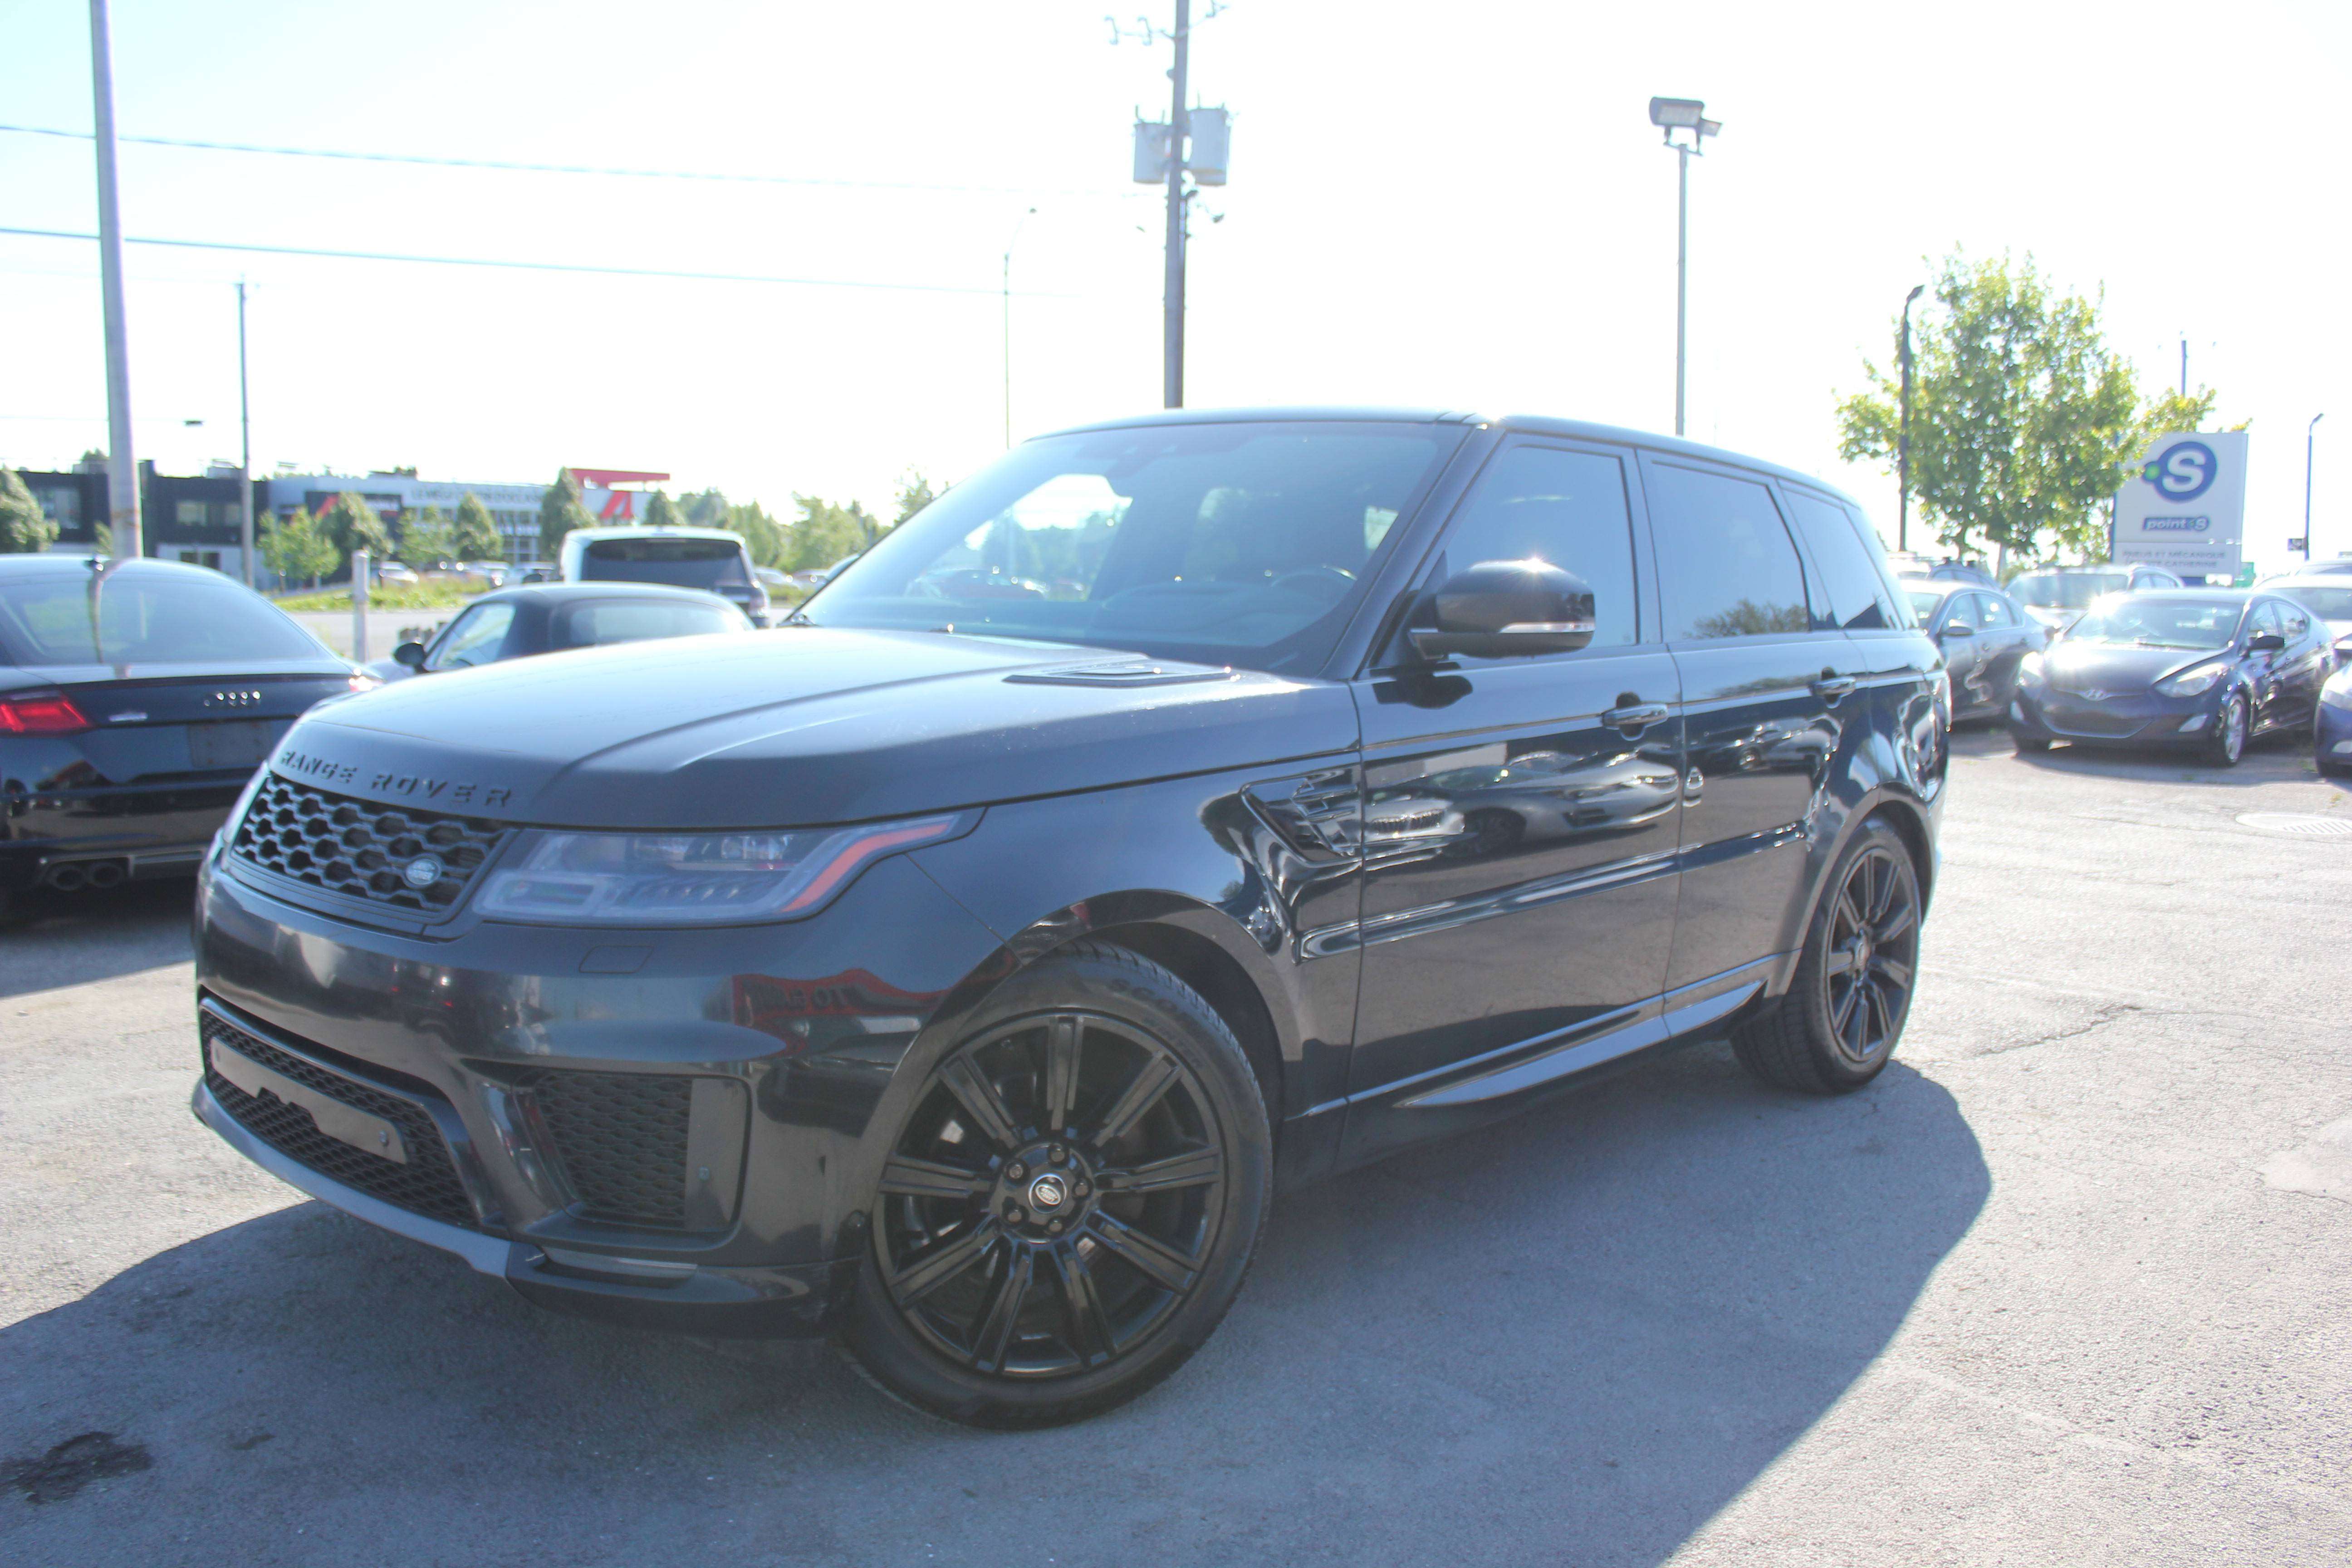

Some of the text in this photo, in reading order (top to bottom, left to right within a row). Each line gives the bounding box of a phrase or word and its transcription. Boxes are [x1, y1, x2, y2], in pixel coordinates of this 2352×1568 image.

[2161, 447, 2205, 494] S
[2147, 518, 2187, 530] point
[281, 750, 512, 808] RANGE ROVER
